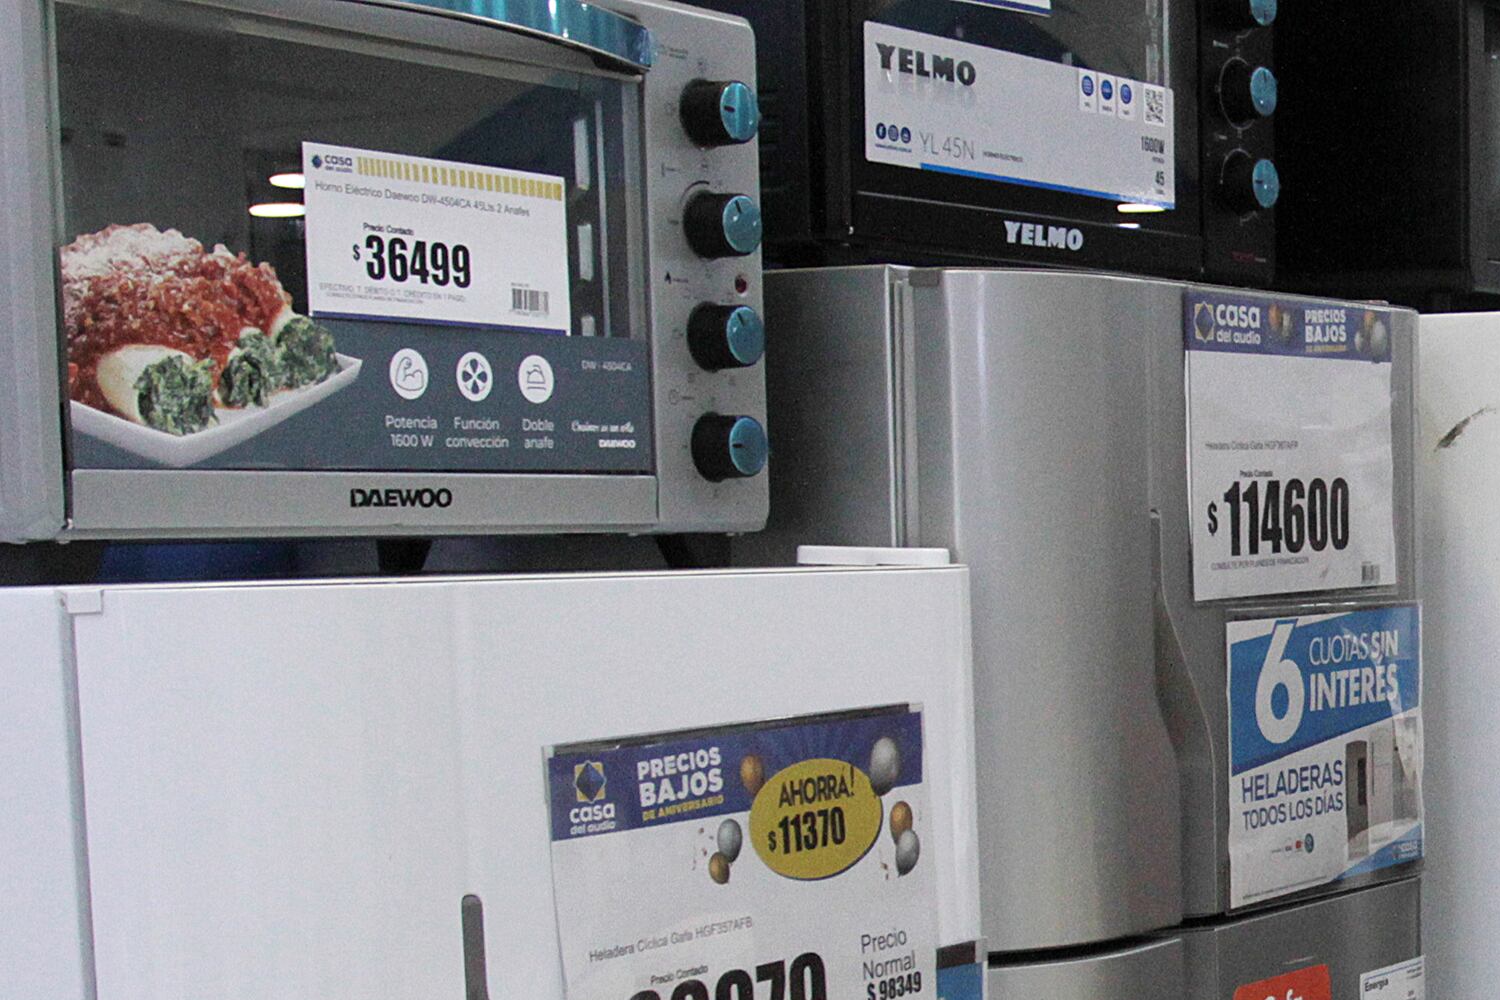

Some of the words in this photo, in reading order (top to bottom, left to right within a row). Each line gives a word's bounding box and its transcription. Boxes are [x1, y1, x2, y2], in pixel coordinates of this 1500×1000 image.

[875, 43, 976, 86] YELMO
[324, 154, 353, 167] casa
[1155, 170, 1165, 186] 45
[315, 181, 343, 193] Horno
[384, 189, 420, 203] Daewoo
[1004, 221, 1084, 251] YELMO
[353, 243, 361, 261] $
[365, 234, 471, 288] 36499
[1216, 304, 1260, 328] casa
[1305, 309, 1346, 323] PRECIOS
[1216, 329, 1232, 341] del
[1233, 330, 1261, 344] audio
[1305, 325, 1347, 342] BAJOS
[385, 415, 437, 430] Potencia
[454, 416, 500, 431] Función
[522, 418, 555, 431] Doble
[390, 433, 418, 447] 1600
[420, 434, 434, 447] W
[446, 435, 509, 448] convección
[524, 436, 554, 449] anafe
[350, 487, 452, 508] DAEWOO
[1207, 501, 1218, 536] $
[1224, 477, 1349, 556] 114600
[1309, 632, 1370, 666] CUOTAS
[1370, 629, 1399, 659] SIN
[1255, 622, 1305, 743] 6
[1309, 657, 1399, 711] INTERÉS
[637, 747, 721, 782] PRECIOS
[638, 768, 723, 808] BAJOS
[778, 765, 855, 808] AHORRÁ!
[1242, 760, 1343, 803] HELADERAS
[570, 802, 615, 823] casa
[642, 808, 657, 821] DE
[658, 795, 724, 819] ANIVERSARIO
[1243, 802, 1286, 831] TODOS
[1289, 798, 1313, 821] LOS
[1315, 790, 1344, 814] DÍAS
[570, 822, 590, 835] del
[591, 819, 616, 833] audio
[768, 830, 777, 853] $
[778, 806, 846, 855] 11370
[589, 941, 635, 962] Heladera
[637, 933, 668, 952] Cíclica
[670, 929, 694, 945] Gafa
[861, 929, 907, 954] Precio
[650, 970, 674, 986] Precio
[675, 963, 709, 980] Contado
[863, 951, 916, 979] Normal
